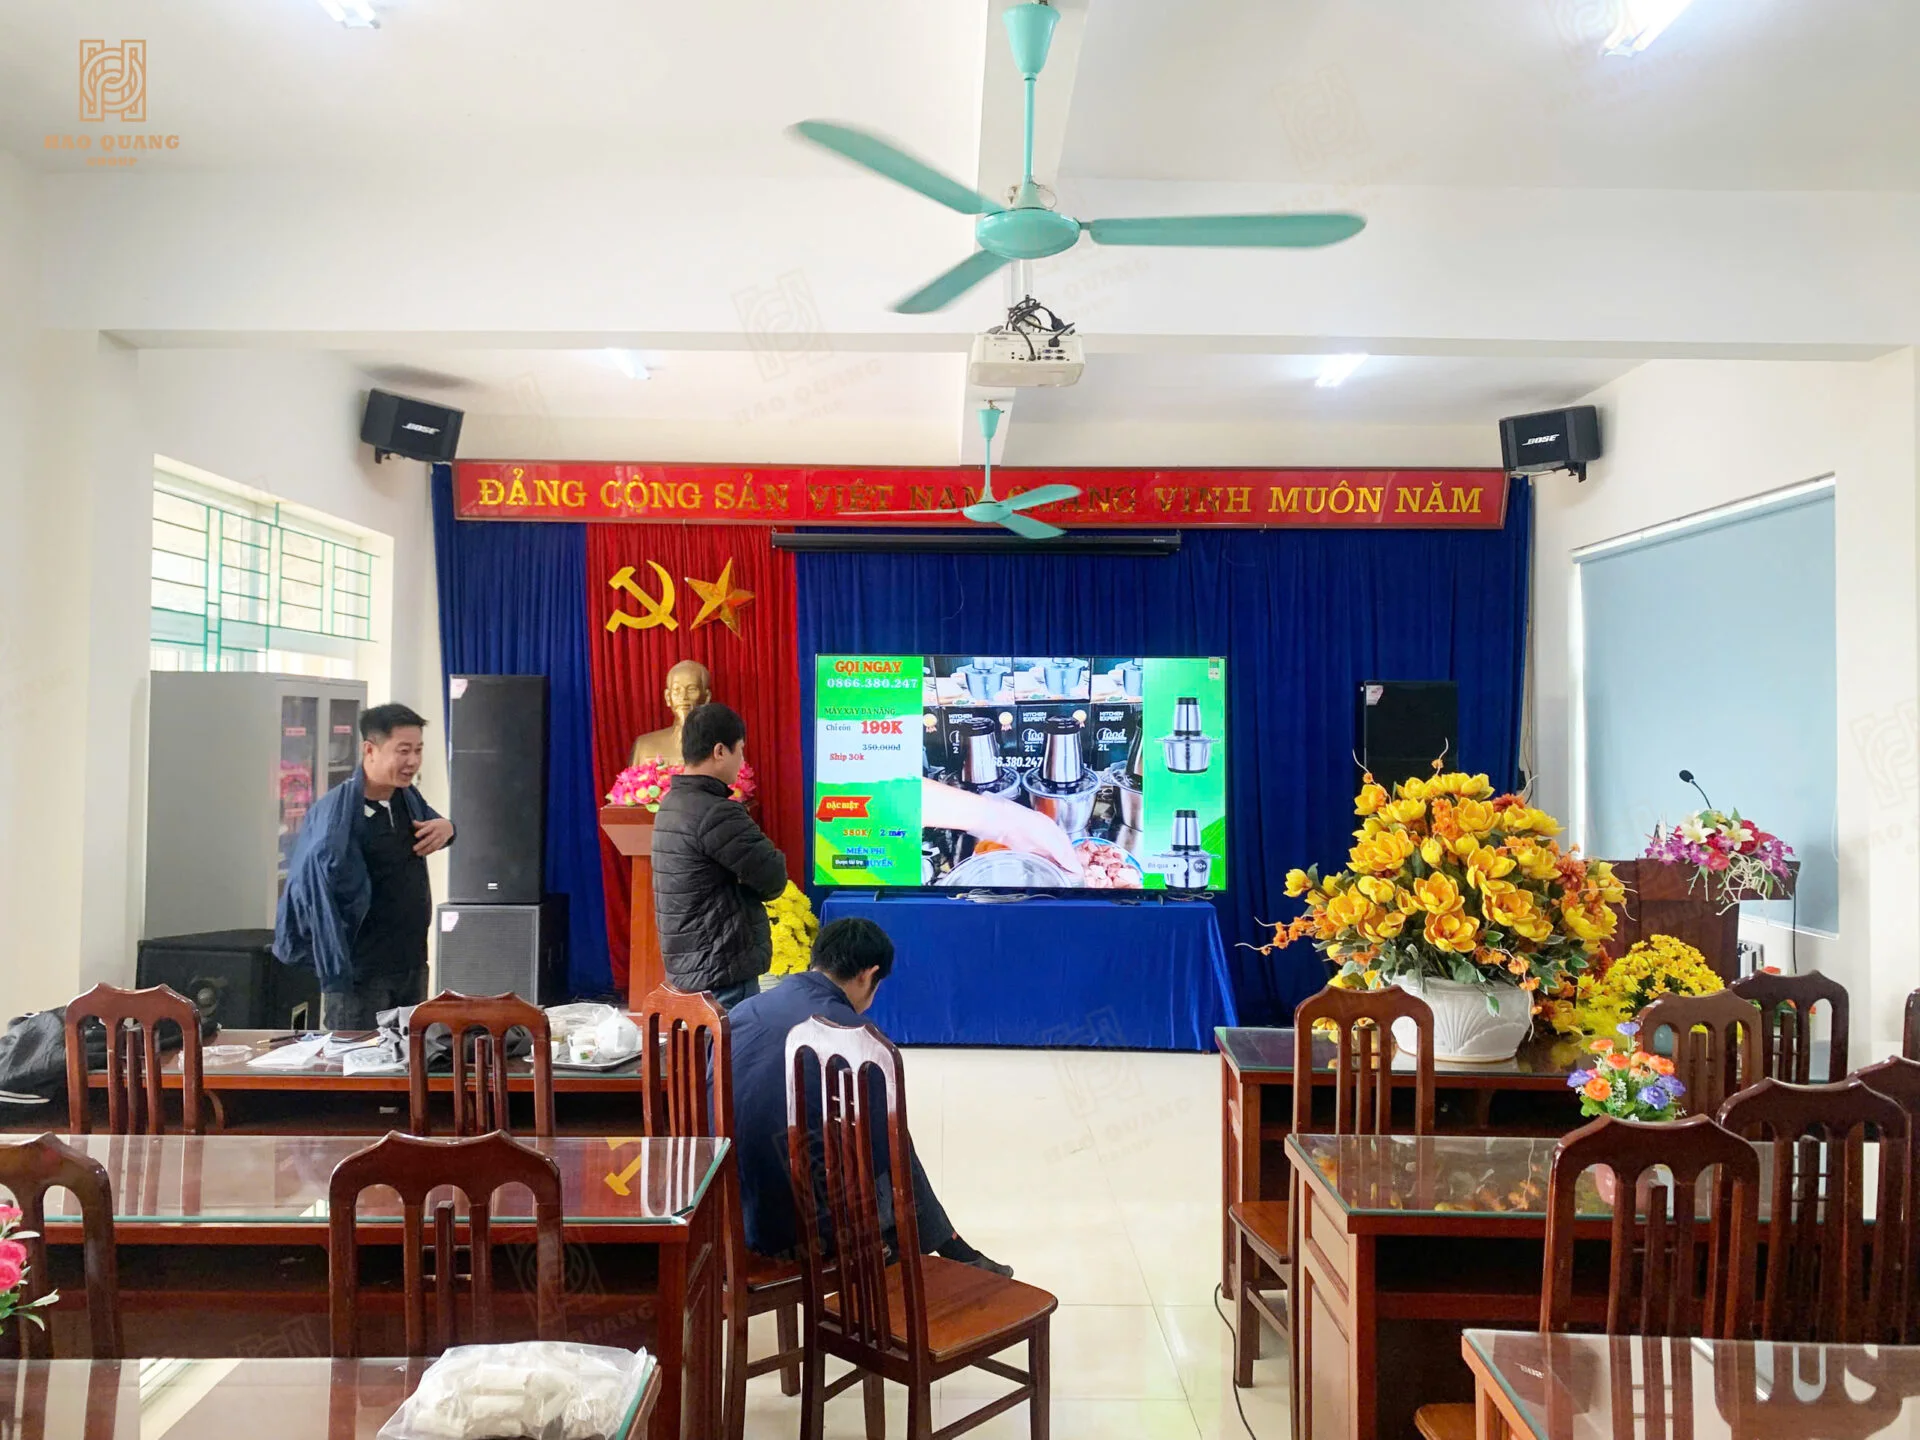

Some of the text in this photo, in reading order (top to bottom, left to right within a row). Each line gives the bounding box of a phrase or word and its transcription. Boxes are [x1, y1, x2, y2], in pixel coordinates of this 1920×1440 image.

[401, 422, 440, 435] BOSE
[1521, 433, 1560, 446] BOSE
[477, 467, 588, 508] ĐẢNG
[600, 474, 703, 514] CỘNG
[714, 472, 789, 511] SẢN
[807, 478, 894, 513] VIỆT
[1155, 486, 1253, 514] VINH
[1267, 480, 1384, 514] MUÔN
[1394, 482, 1484, 514] NĂM
[834, 660, 903, 676] GỌI NGAY
[826, 678, 918, 689] 0866.380.247
[861, 720, 903, 735] 199K
[1098, 743, 1110, 751] 2L
[829, 753, 865, 762] Ship 30k
